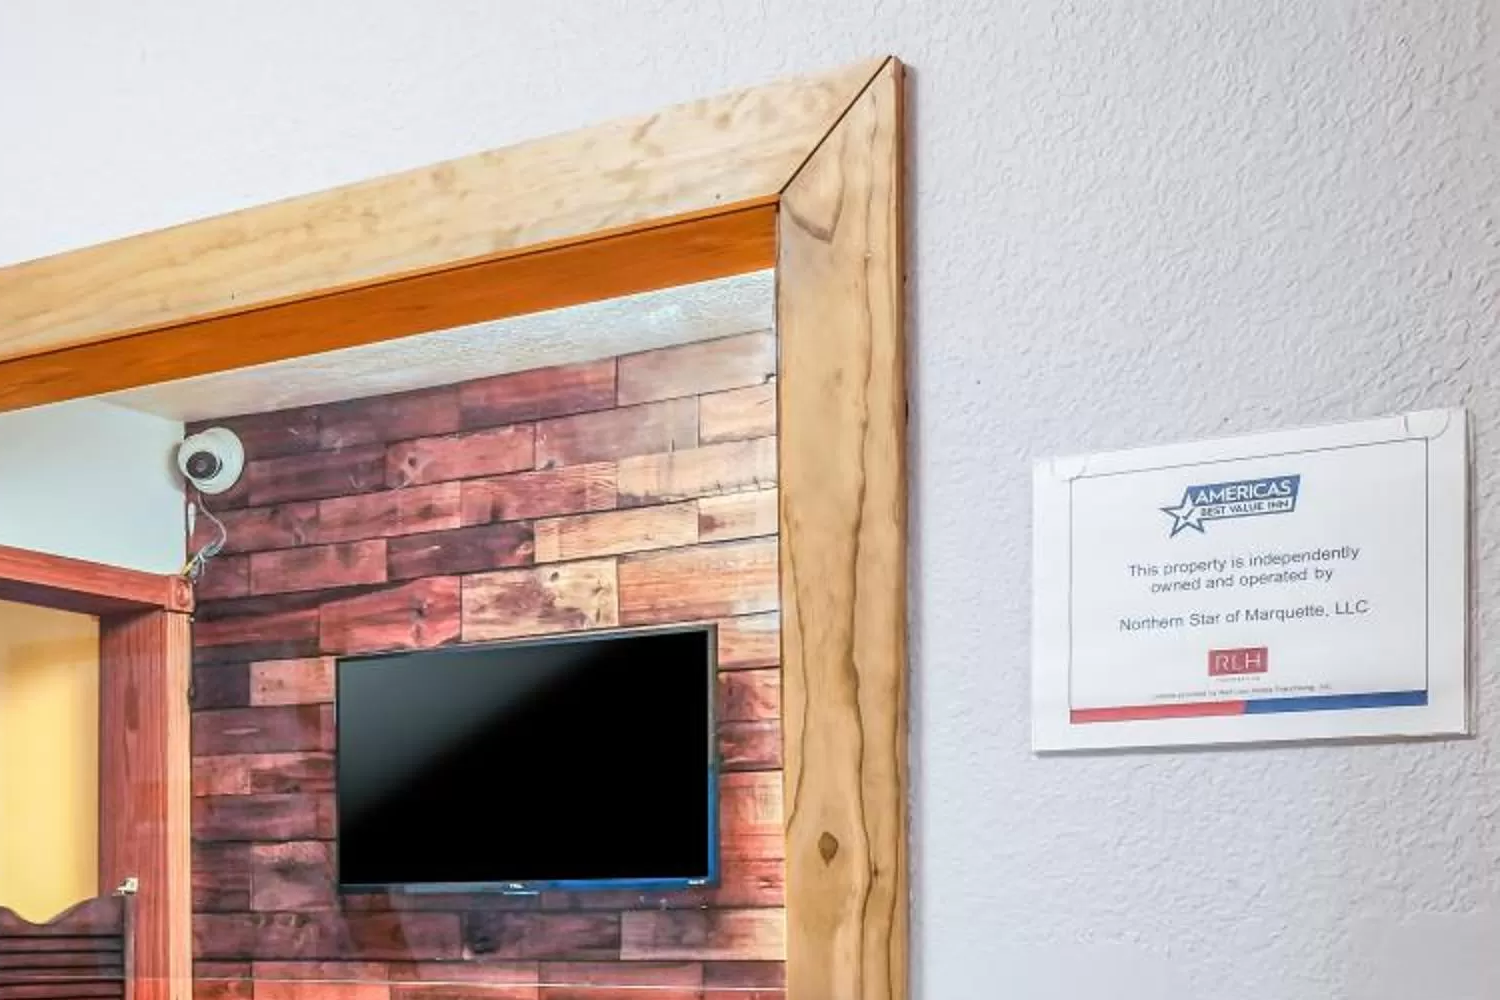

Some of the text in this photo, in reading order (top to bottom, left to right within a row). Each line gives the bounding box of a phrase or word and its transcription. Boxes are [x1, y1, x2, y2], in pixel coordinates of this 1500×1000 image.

[1195, 479, 1292, 504] AMERICAS
[1201, 505, 1226, 517] BEST
[1230, 502, 1265, 515] VALUE
[1127, 546, 1361, 577] This property is independently
[1150, 566, 1334, 593] owned and operated by
[1119, 599, 1370, 632] Northern Star of Marquette, LLC
[1215, 651, 1261, 673] RLH
